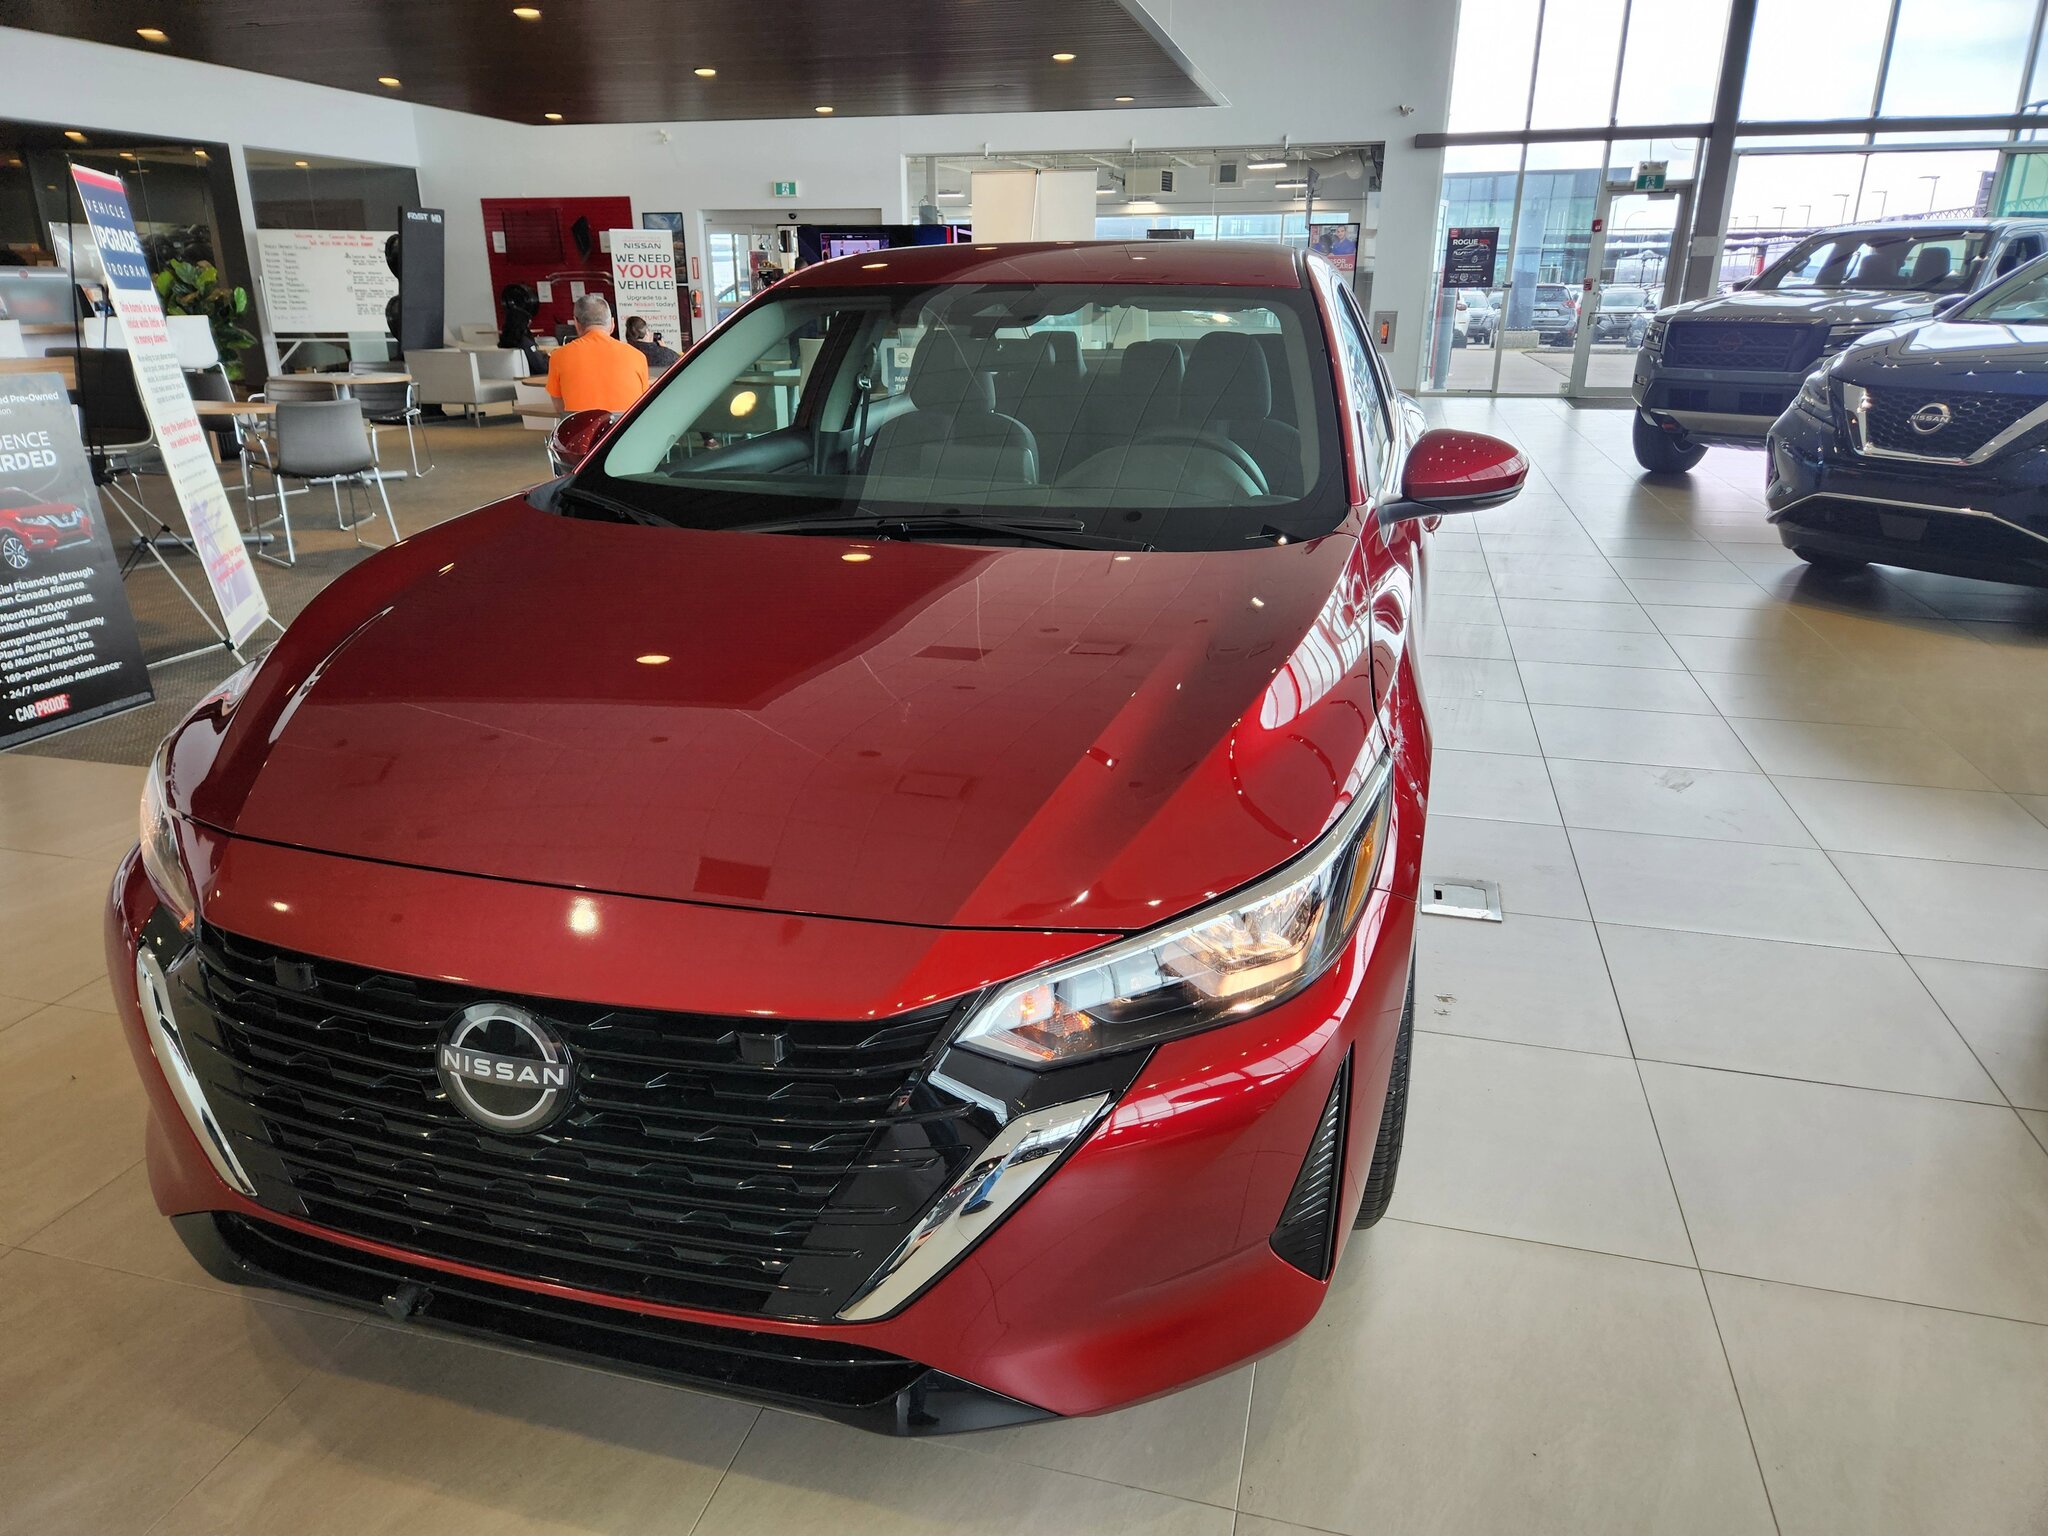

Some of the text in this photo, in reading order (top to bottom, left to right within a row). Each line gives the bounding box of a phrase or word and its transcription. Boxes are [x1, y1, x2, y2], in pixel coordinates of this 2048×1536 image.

[85, 199, 126, 219] VEHICLE
[1452, 238, 1479, 246] ROGUE
[615, 253, 671, 263] WE NEED
[616, 264, 672, 278] YOUR
[618, 280, 674, 290] VEHICLE!
[10, 391, 59, 403] Pre-Owned
[1910, 414, 1950, 424] NISSAN
[0, 431, 51, 451] ENCE
[14, 575, 58, 591] Financing
[58, 566, 94, 581] through
[15, 589, 50, 603] Canada
[50, 581, 85, 595] Finance
[73, 593, 94, 605] KMS
[64, 616, 105, 632] Warranty
[25, 637, 66, 654] Available
[66, 634, 79, 644] up
[78, 631, 89, 640] to
[0, 662, 14, 671] 96
[74, 640, 95, 652] Kms
[4, 653, 96, 684] 169-point Inspection
[8, 685, 32, 700] 24/7
[32, 674, 75, 693] Roadside
[444, 1049, 565, 1086] NISSAN
